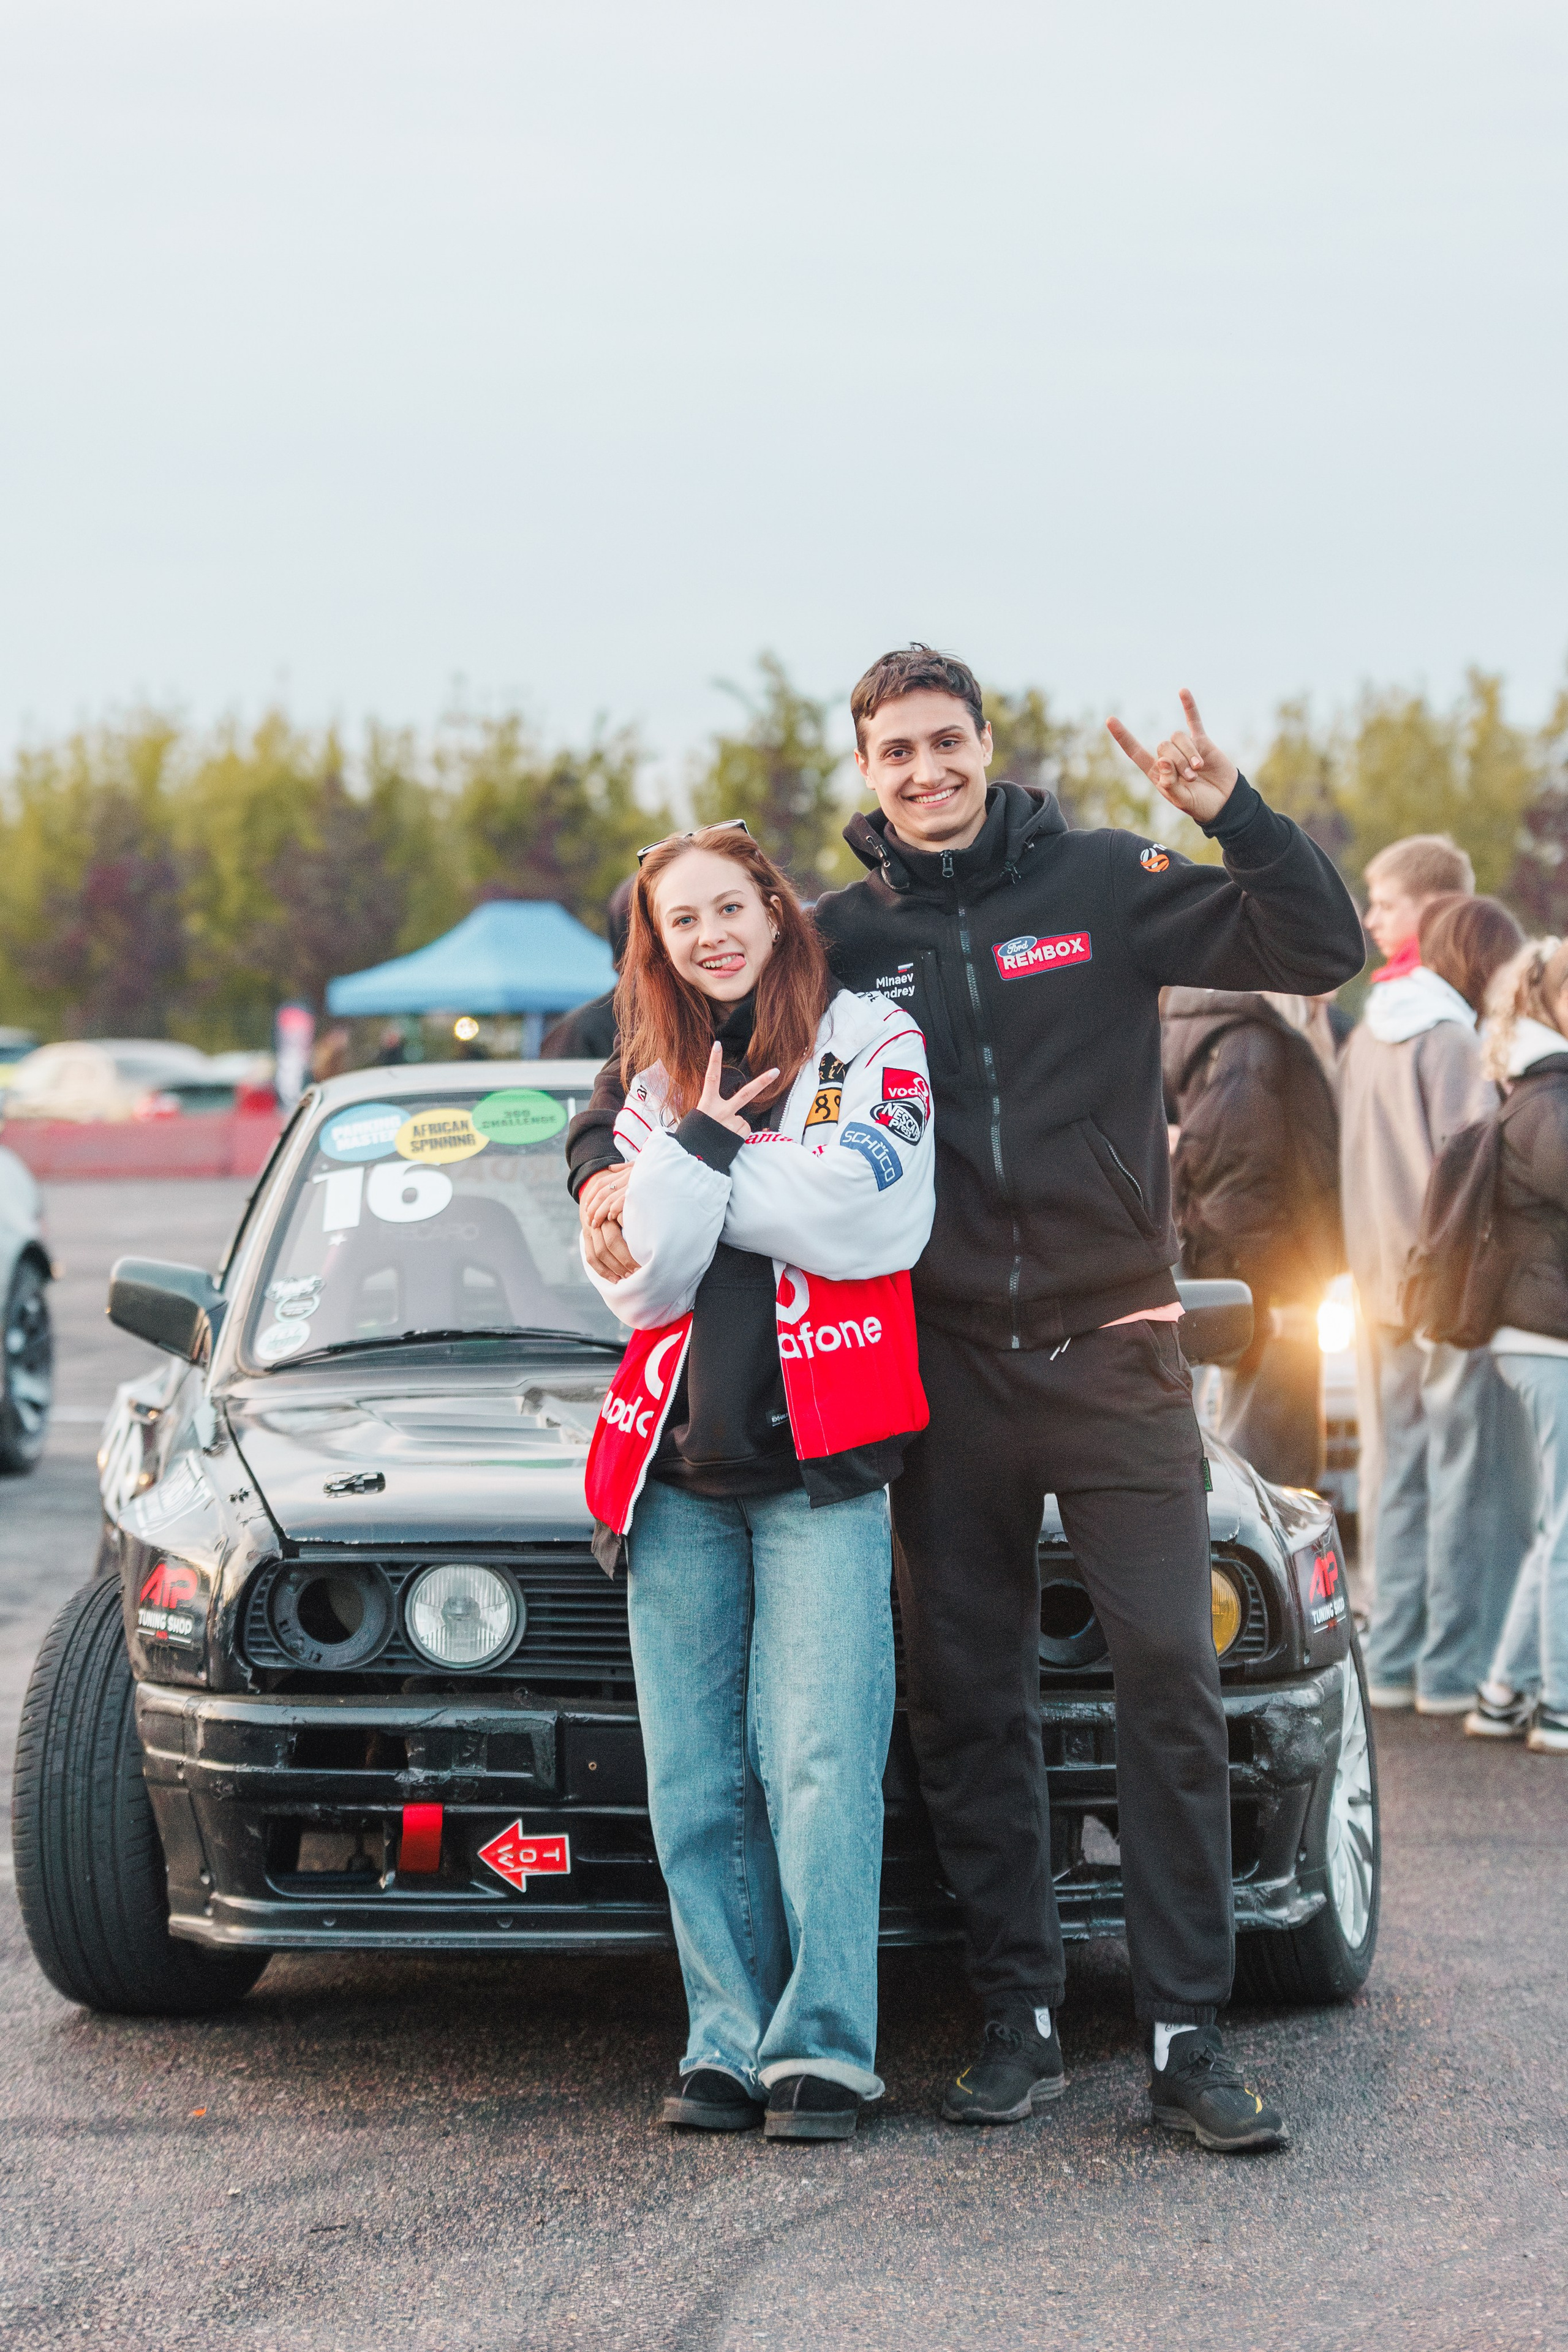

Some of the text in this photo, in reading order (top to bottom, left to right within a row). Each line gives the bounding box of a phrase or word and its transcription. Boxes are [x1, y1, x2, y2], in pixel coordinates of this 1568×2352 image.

[1003, 938, 1085, 970] REMBOX
[1007, 940, 1028, 954] Ford
[876, 973, 914, 989] Minaev
[881, 985, 915, 999] ndrey
[413, 1120, 469, 1137] AFRICAN
[410, 1133, 477, 1153] SPINNING
[312, 1161, 453, 1232] 16
[138, 1608, 167, 1630] TUNING
[167, 1615, 192, 1635] SHOP
[1311, 1602, 1334, 1626] TUNING
[497, 1843, 560, 1868] TOW
